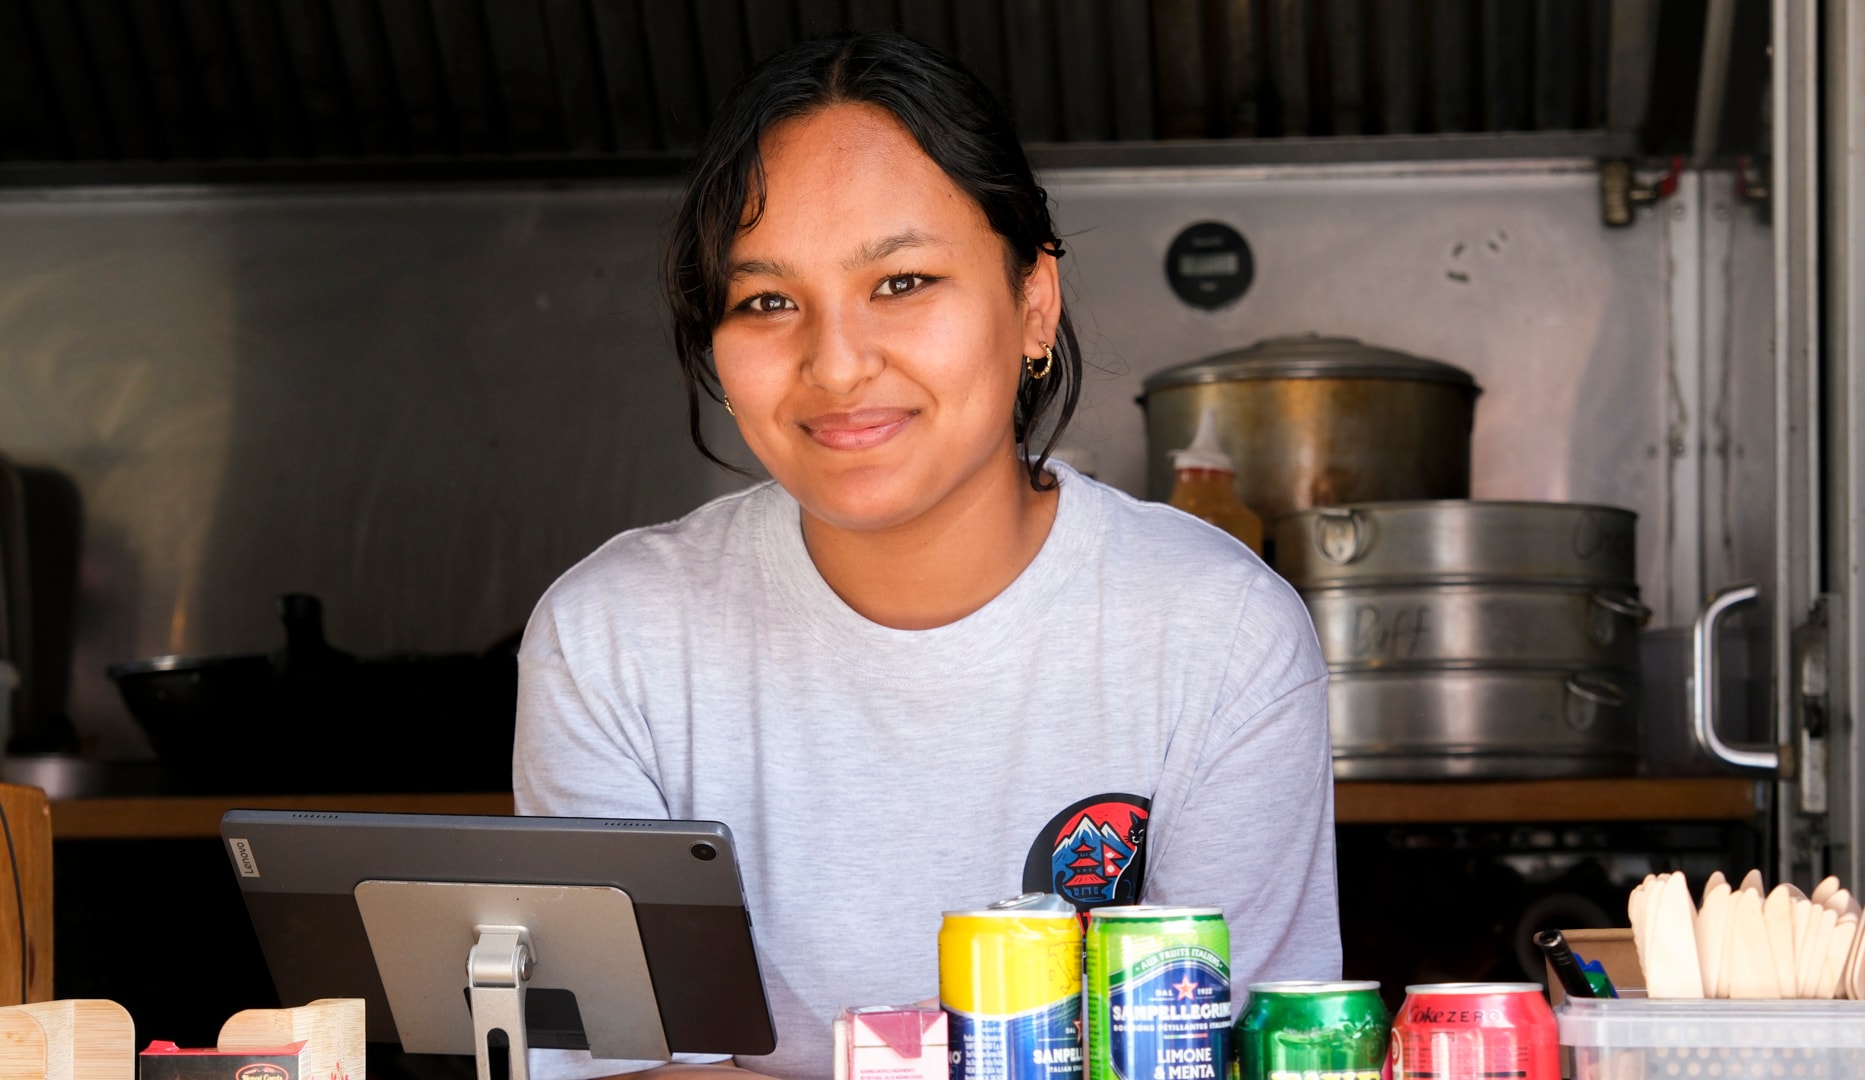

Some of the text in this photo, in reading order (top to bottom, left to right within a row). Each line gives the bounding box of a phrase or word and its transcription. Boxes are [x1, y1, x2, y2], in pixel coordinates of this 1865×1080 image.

[237, 842, 254, 874] Lenovo
[1141, 956, 1159, 970] AUX
[1159, 948, 1190, 961] FRUITS
[1155, 989, 1173, 997] DAL
[1407, 1005, 1501, 1024] Coke ZERO
[1157, 1048, 1212, 1063] LIMONE
[1154, 1064, 1215, 1080] & MENTA
